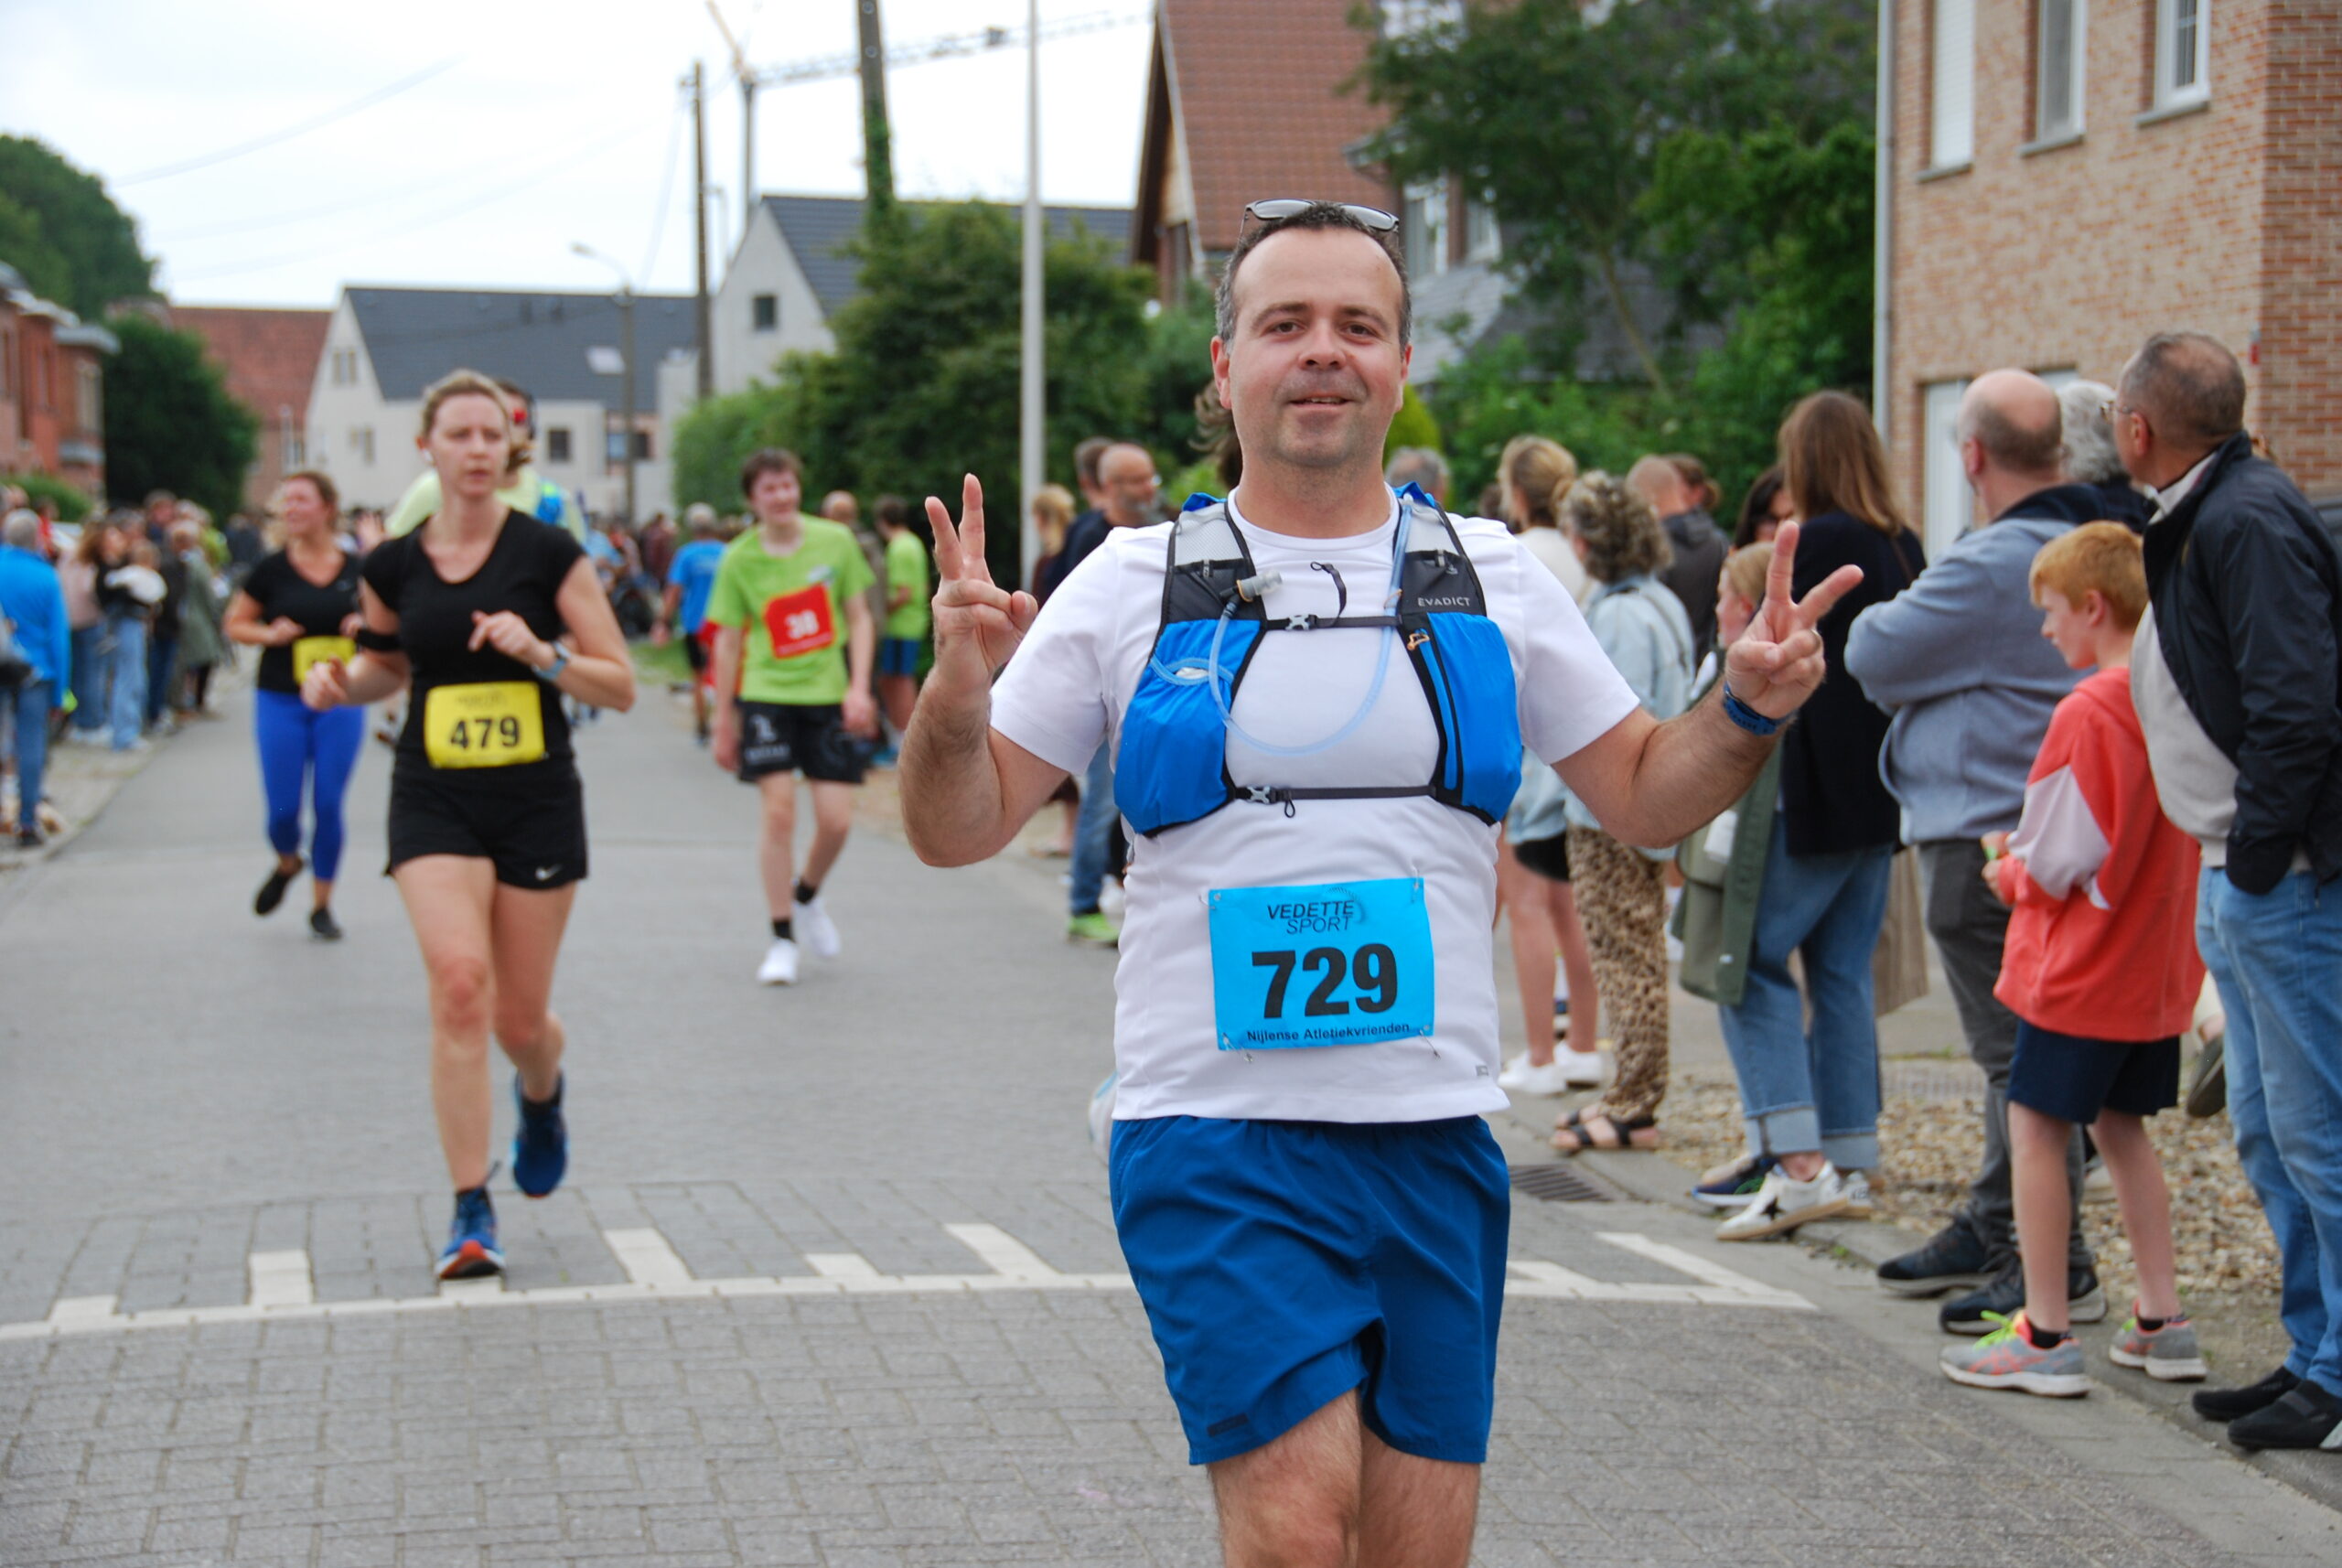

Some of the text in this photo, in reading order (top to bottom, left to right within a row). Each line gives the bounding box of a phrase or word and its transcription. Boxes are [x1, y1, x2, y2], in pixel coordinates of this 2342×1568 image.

[1417, 596, 1471, 607] EVADICT
[449, 715, 521, 750] 479
[1267, 899, 1355, 919] VEDETTE
[1286, 917, 1352, 935] SPORT
[1252, 943, 1398, 1019] 729
[1247, 1023, 1410, 1044] Nijlense Atletiekvrienden
